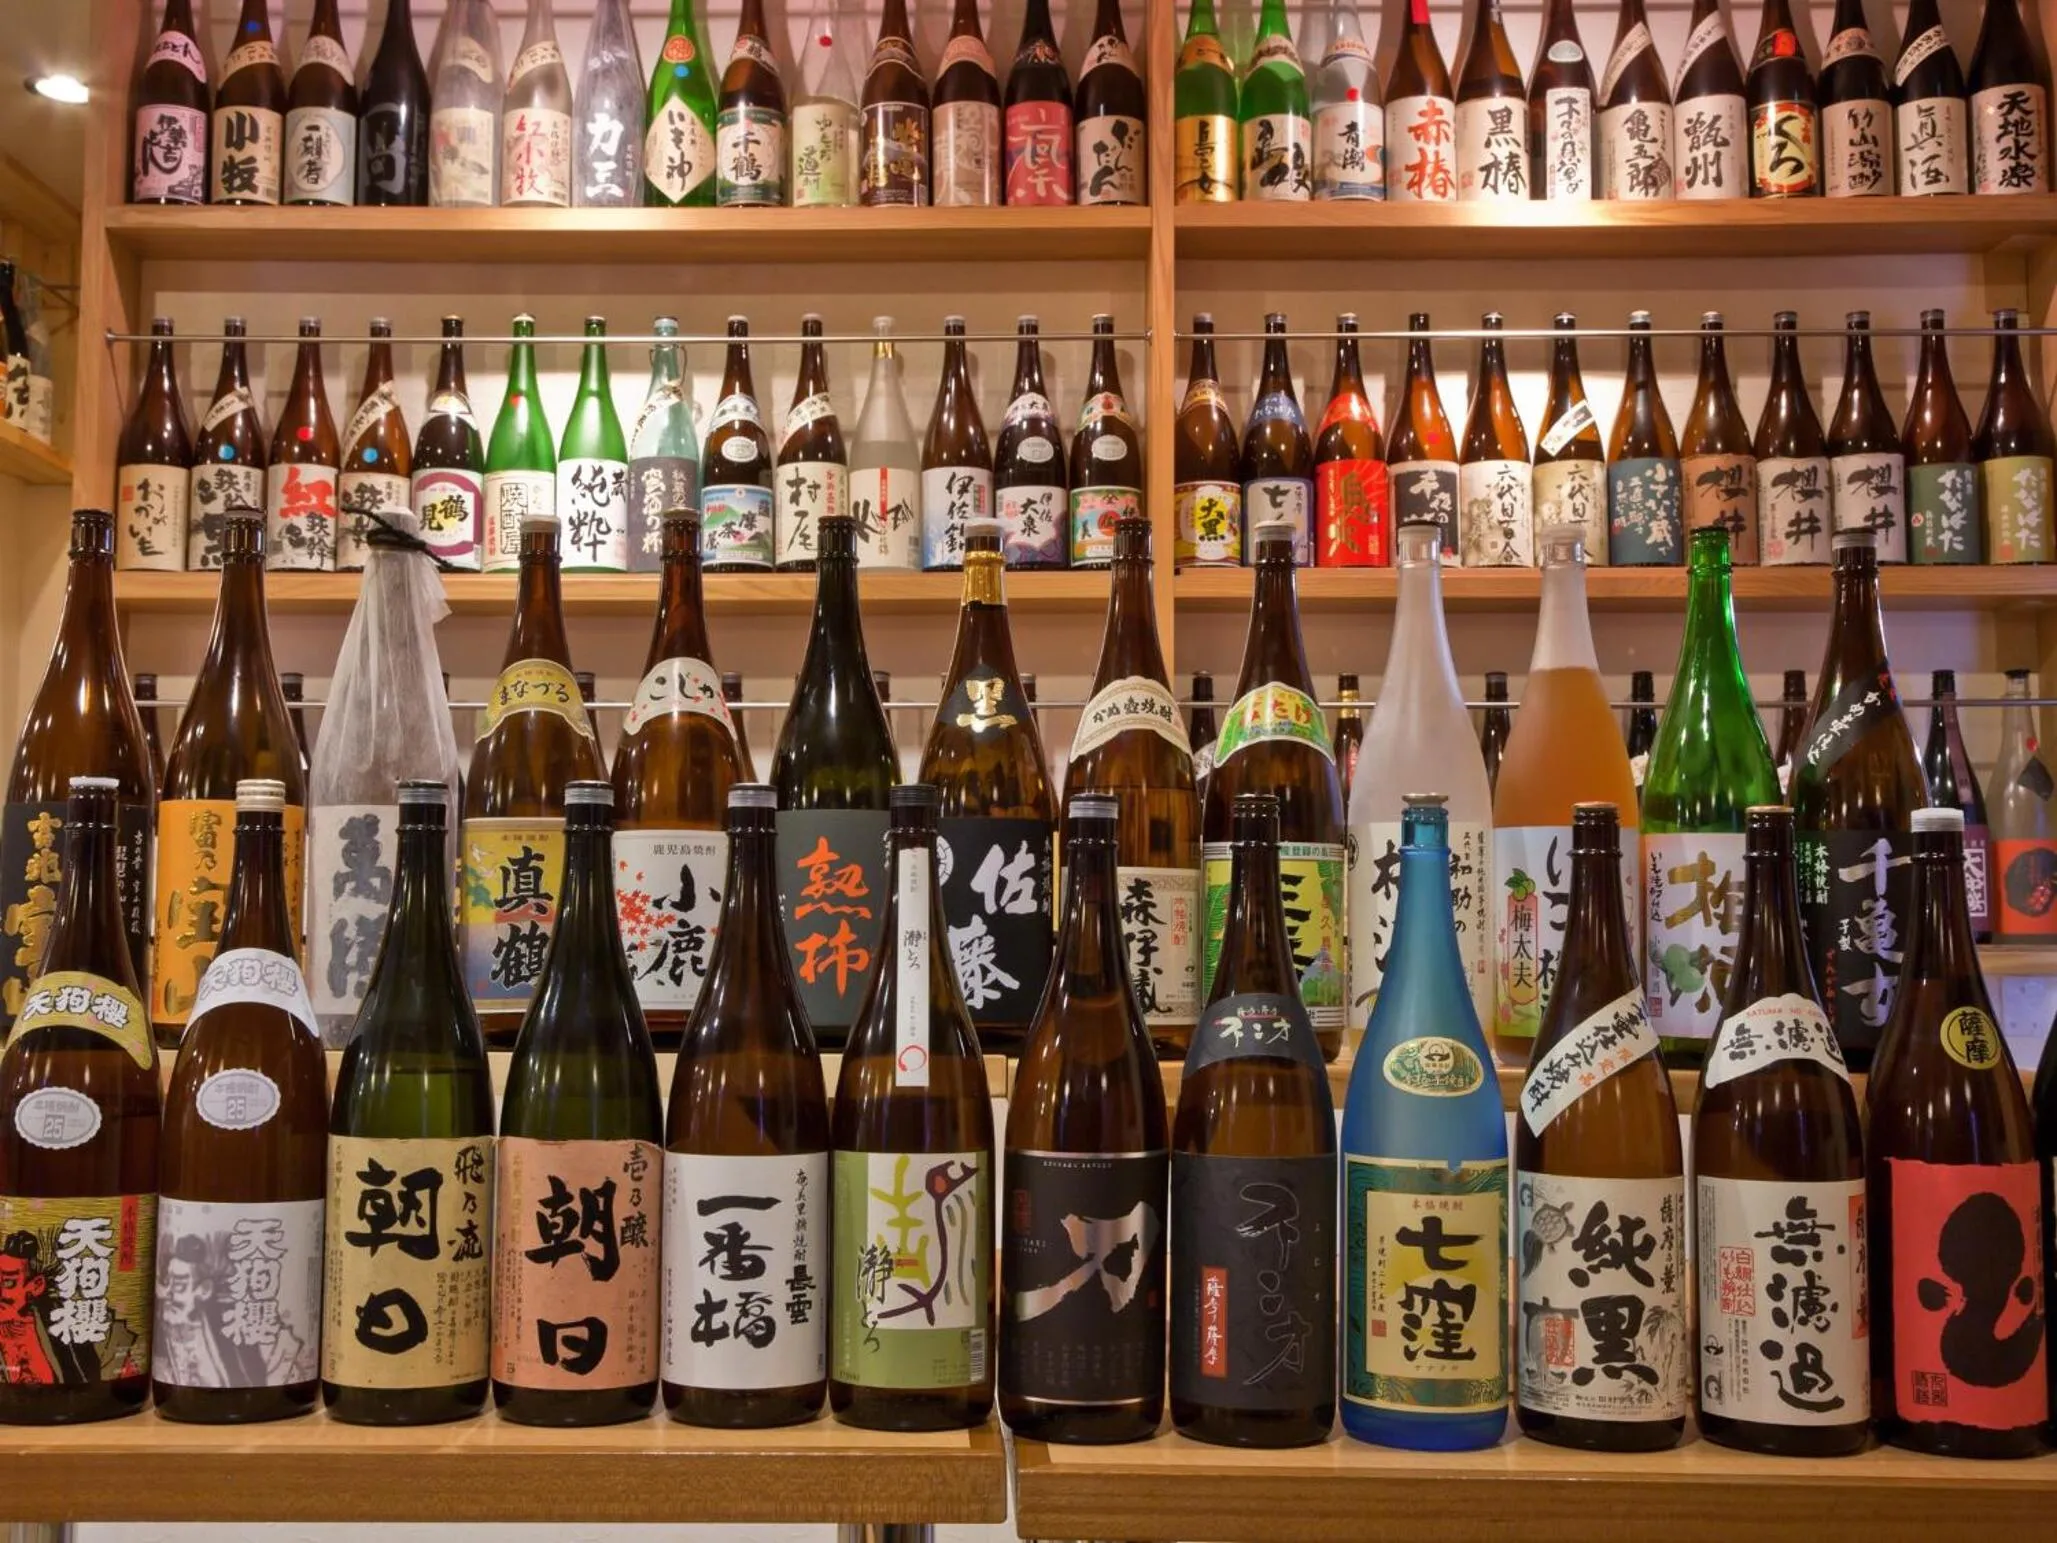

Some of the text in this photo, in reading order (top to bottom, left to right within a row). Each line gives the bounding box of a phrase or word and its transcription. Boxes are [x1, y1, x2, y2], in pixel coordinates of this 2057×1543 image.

[514, 114, 547, 196] 紅小牧
[584, 113, 626, 197] 力三
[731, 131, 762, 182] 千鶴
[1404, 99, 1455, 199] 赤椿
[1480, 106, 1528, 196] 黒椿
[1623, 108, 1661, 196] 亀五郎
[1684, 111, 1730, 189] 甑州
[1767, 113, 1804, 177] くろ
[277, 464, 335, 518] 紅
[784, 466, 820, 555] 村尾
[1018, 497, 1039, 538] 大泉
[1494, 464, 1519, 563] 六代目百合
[303, 512, 329, 568] 鉄幹
[498, 680, 570, 706] まなづる
[956, 678, 1018, 732] 黒
[652, 843, 718, 857] 鹿児島焼酎
[490, 845, 555, 990] 真鶴
[640, 862, 722, 989] 小鹿
[794, 834, 872, 997] 熟柿
[945, 839, 1038, 1011] 佐藤
[1118, 878, 1174, 1015] 森伊蔵
[1511, 903, 1534, 990] 梅太夫
[1219, 1016, 1292, 1049] 不二才
[45, 1117, 64, 1139] 25
[227, 1097, 247, 1120] 25
[447, 1145, 487, 1262] 飛乃流
[345, 1157, 444, 1356] 朝日
[525, 1175, 621, 1376] 朝日
[690, 1194, 784, 1349] 一番橋
[1395, 1216, 1486, 1363] 七窪
[1567, 1199, 1660, 1387] 純黒
[1754, 1195, 1845, 1414] 無濾過
